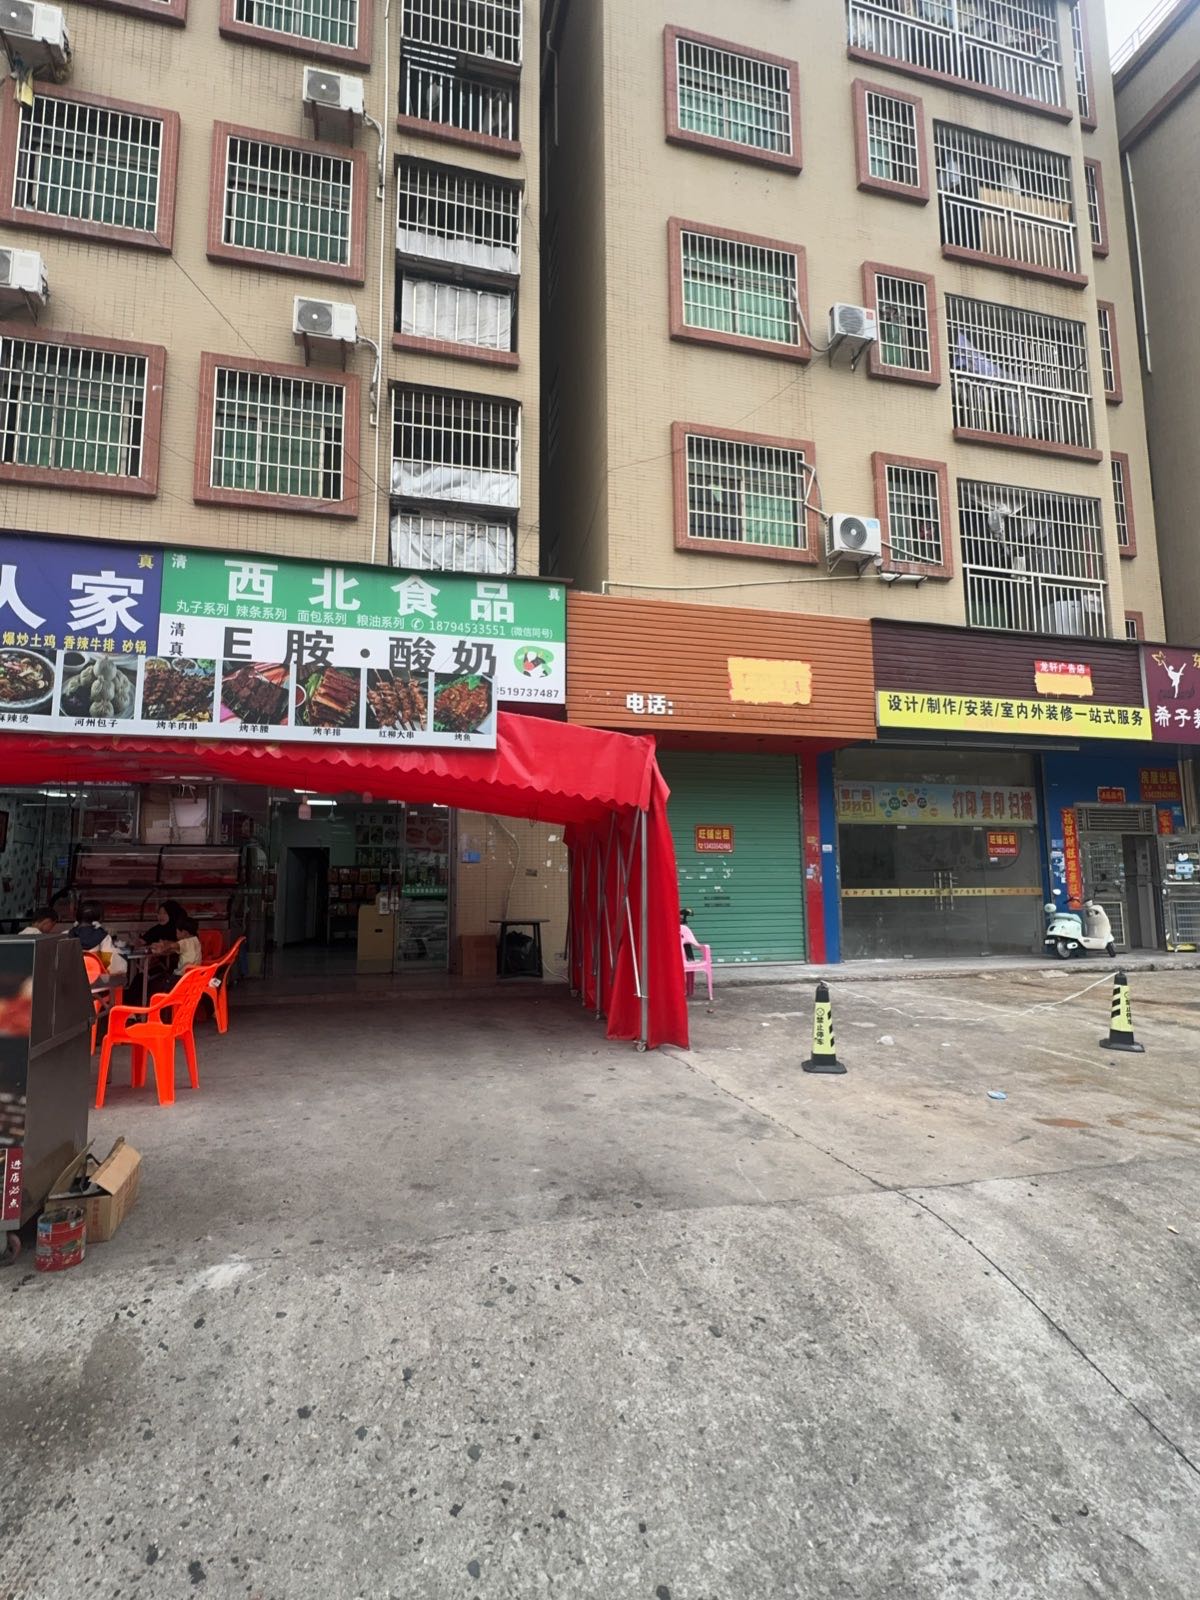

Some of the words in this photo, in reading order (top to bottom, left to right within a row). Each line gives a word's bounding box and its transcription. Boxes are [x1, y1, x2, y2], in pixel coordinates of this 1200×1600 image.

[138, 553, 154, 569] 真
[171, 553, 187, 569] 清
[224, 559, 515, 624] 西北食品
[548, 587, 560, 601] 真
[176, 600, 229, 617] 丸子系列
[236, 604, 287, 621] 辣条系列
[297, 609, 347, 625] 面包系列
[356, 614, 405, 630] 粮油系列
[429, 620, 506, 636] 18794533551
[2, 631, 56, 649] 爆炒土鸡
[63, 635, 115, 653] 香辣牛排
[121, 639, 147, 654] 砂锅
[497, 686, 559, 699] 519737487
[887, 694, 1144, 727] 设计/制作/安装/室内外装修一站式服务
[74, 718, 118, 728] 河州包子
[156, 720, 198, 731] 烤羊肉串
[312, 727, 341, 737] 烤羊排
[378, 729, 415, 740] 红柳大串
[454, 732, 471, 742] 烤鱼
[952, 788, 977, 819] 打印
[1008, 791, 1033, 821] 扫描
[8, 1159, 22, 1209] 进店必点
